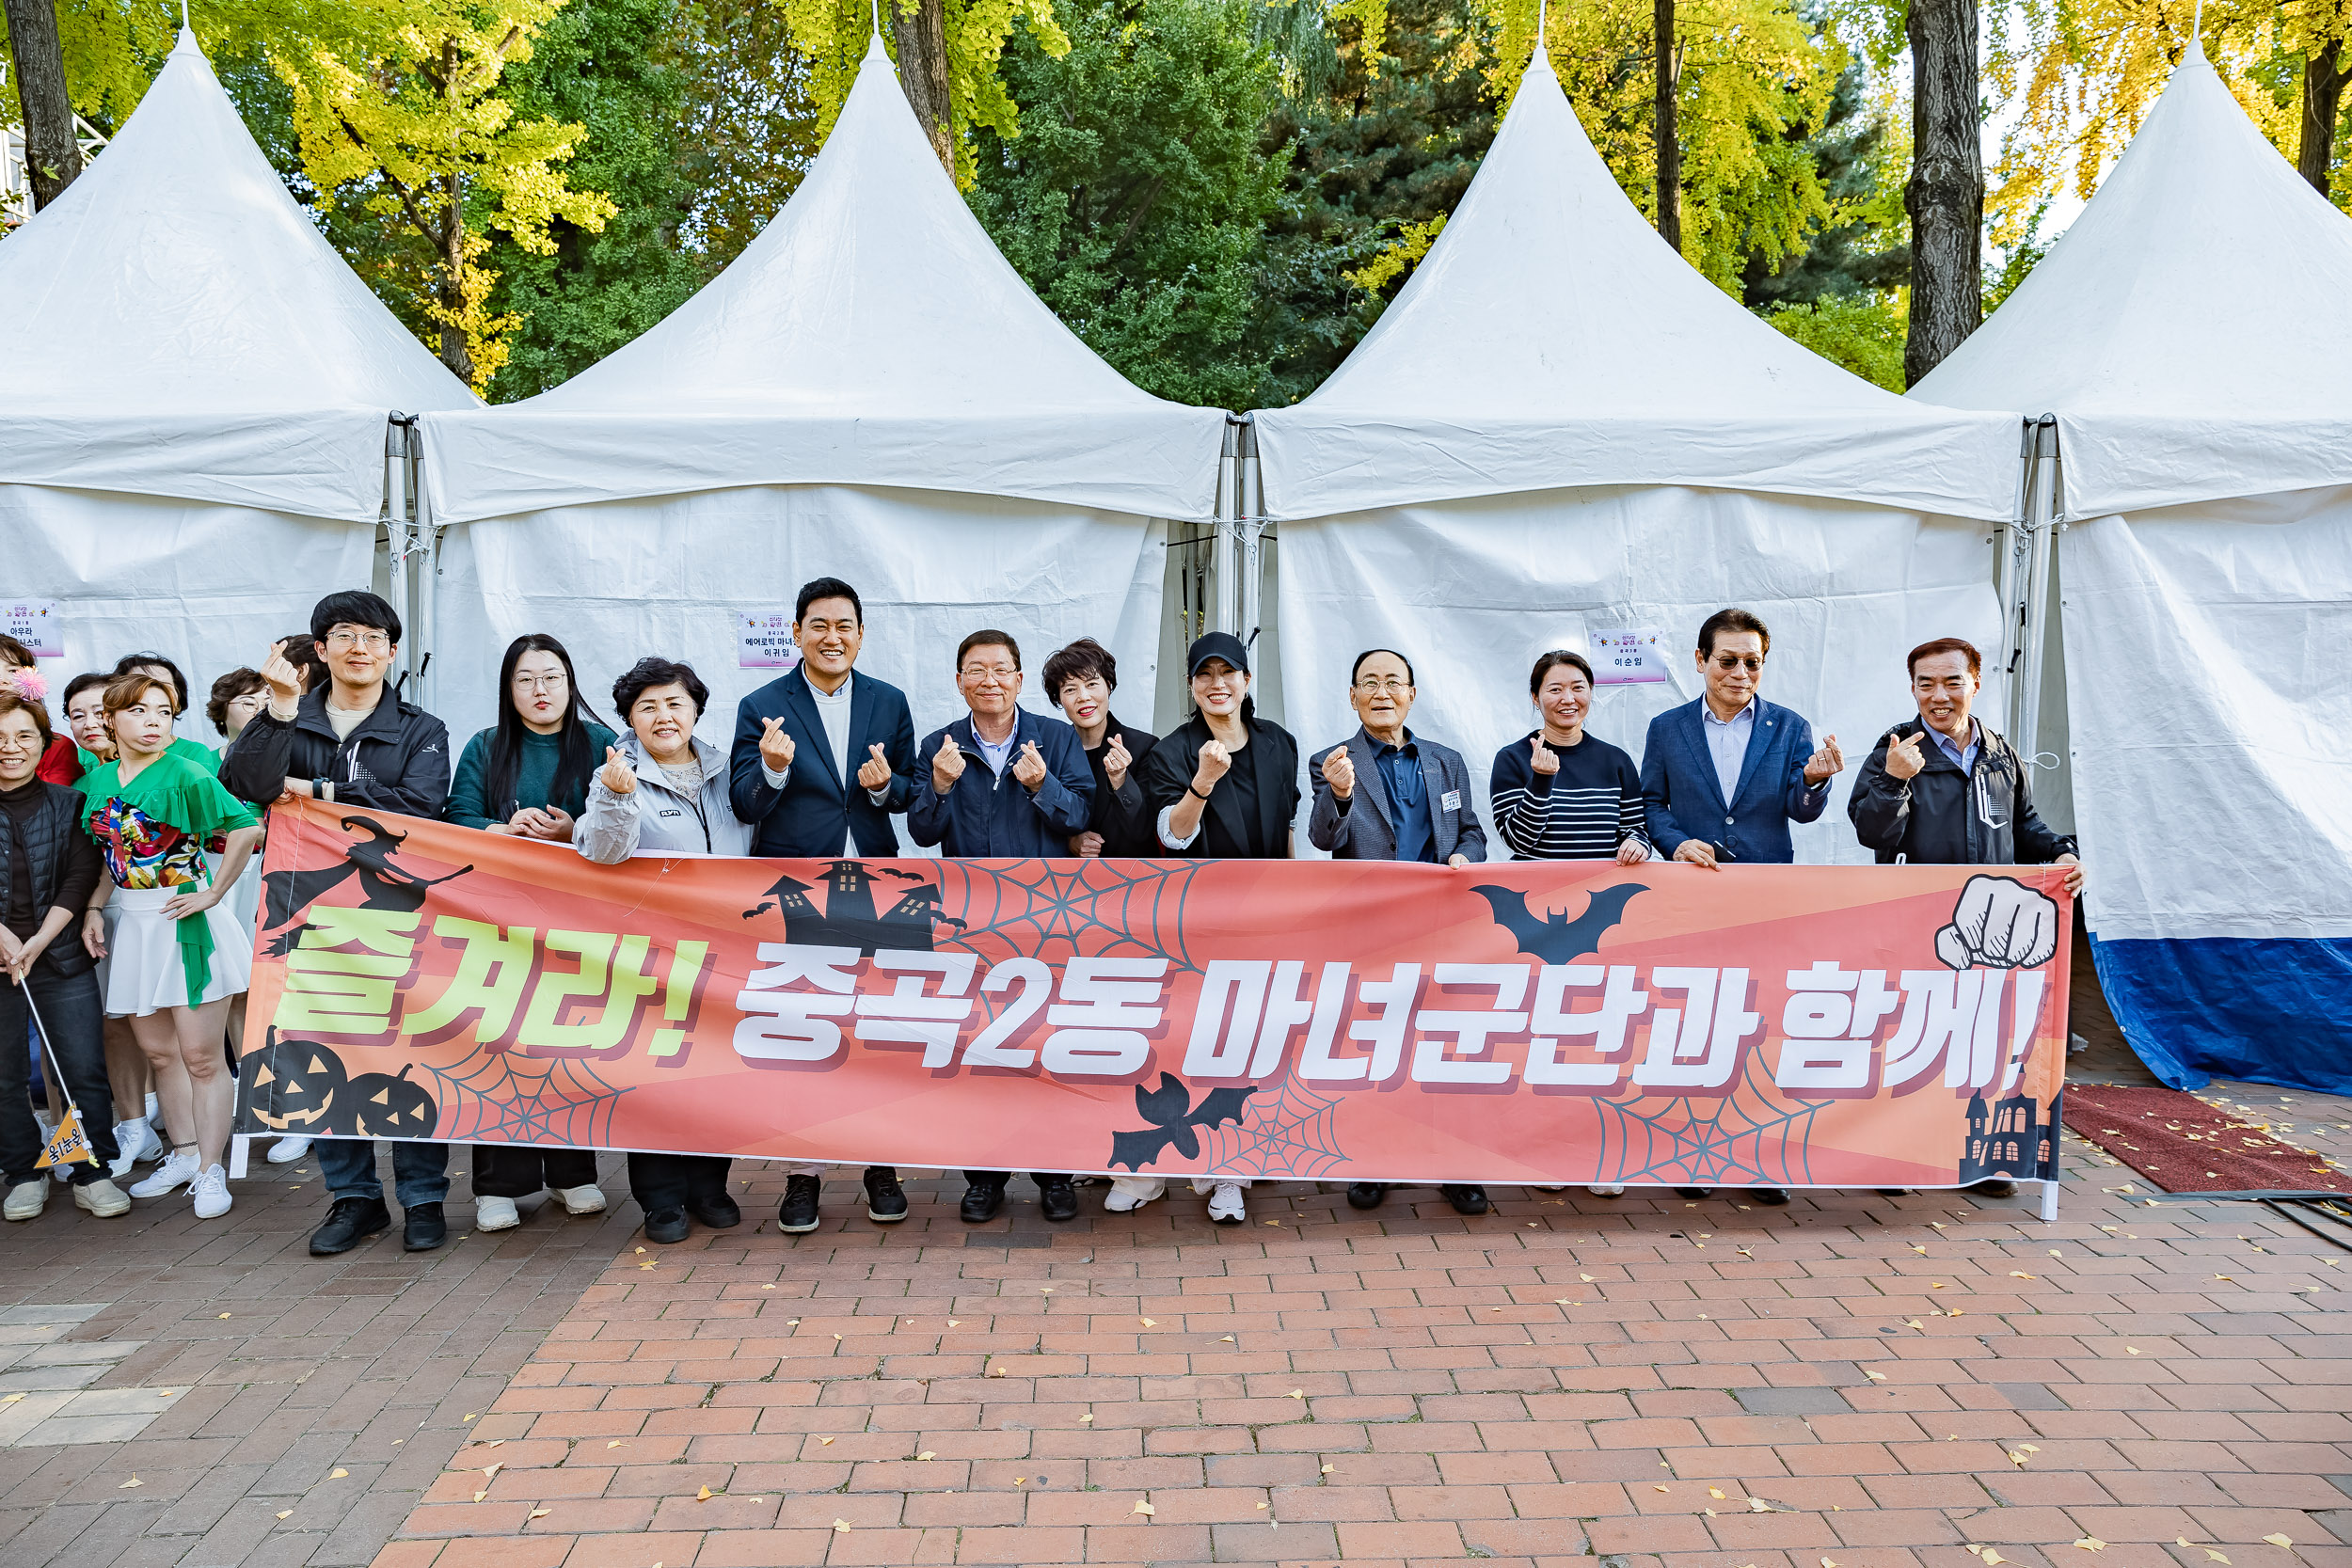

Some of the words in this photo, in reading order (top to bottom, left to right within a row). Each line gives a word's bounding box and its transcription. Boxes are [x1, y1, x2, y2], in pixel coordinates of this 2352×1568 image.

[10, 627, 33, 636] 아우라
[745, 637, 775, 646] 에어로빅
[271, 904, 709, 1057] 즐겨라!
[732, 942, 1169, 1076] 중곡2동
[1181, 958, 1759, 1088] 마녀군단과
[1774, 960, 2046, 1091] 함께!
[48, 1128, 82, 1164] 중곡1동
